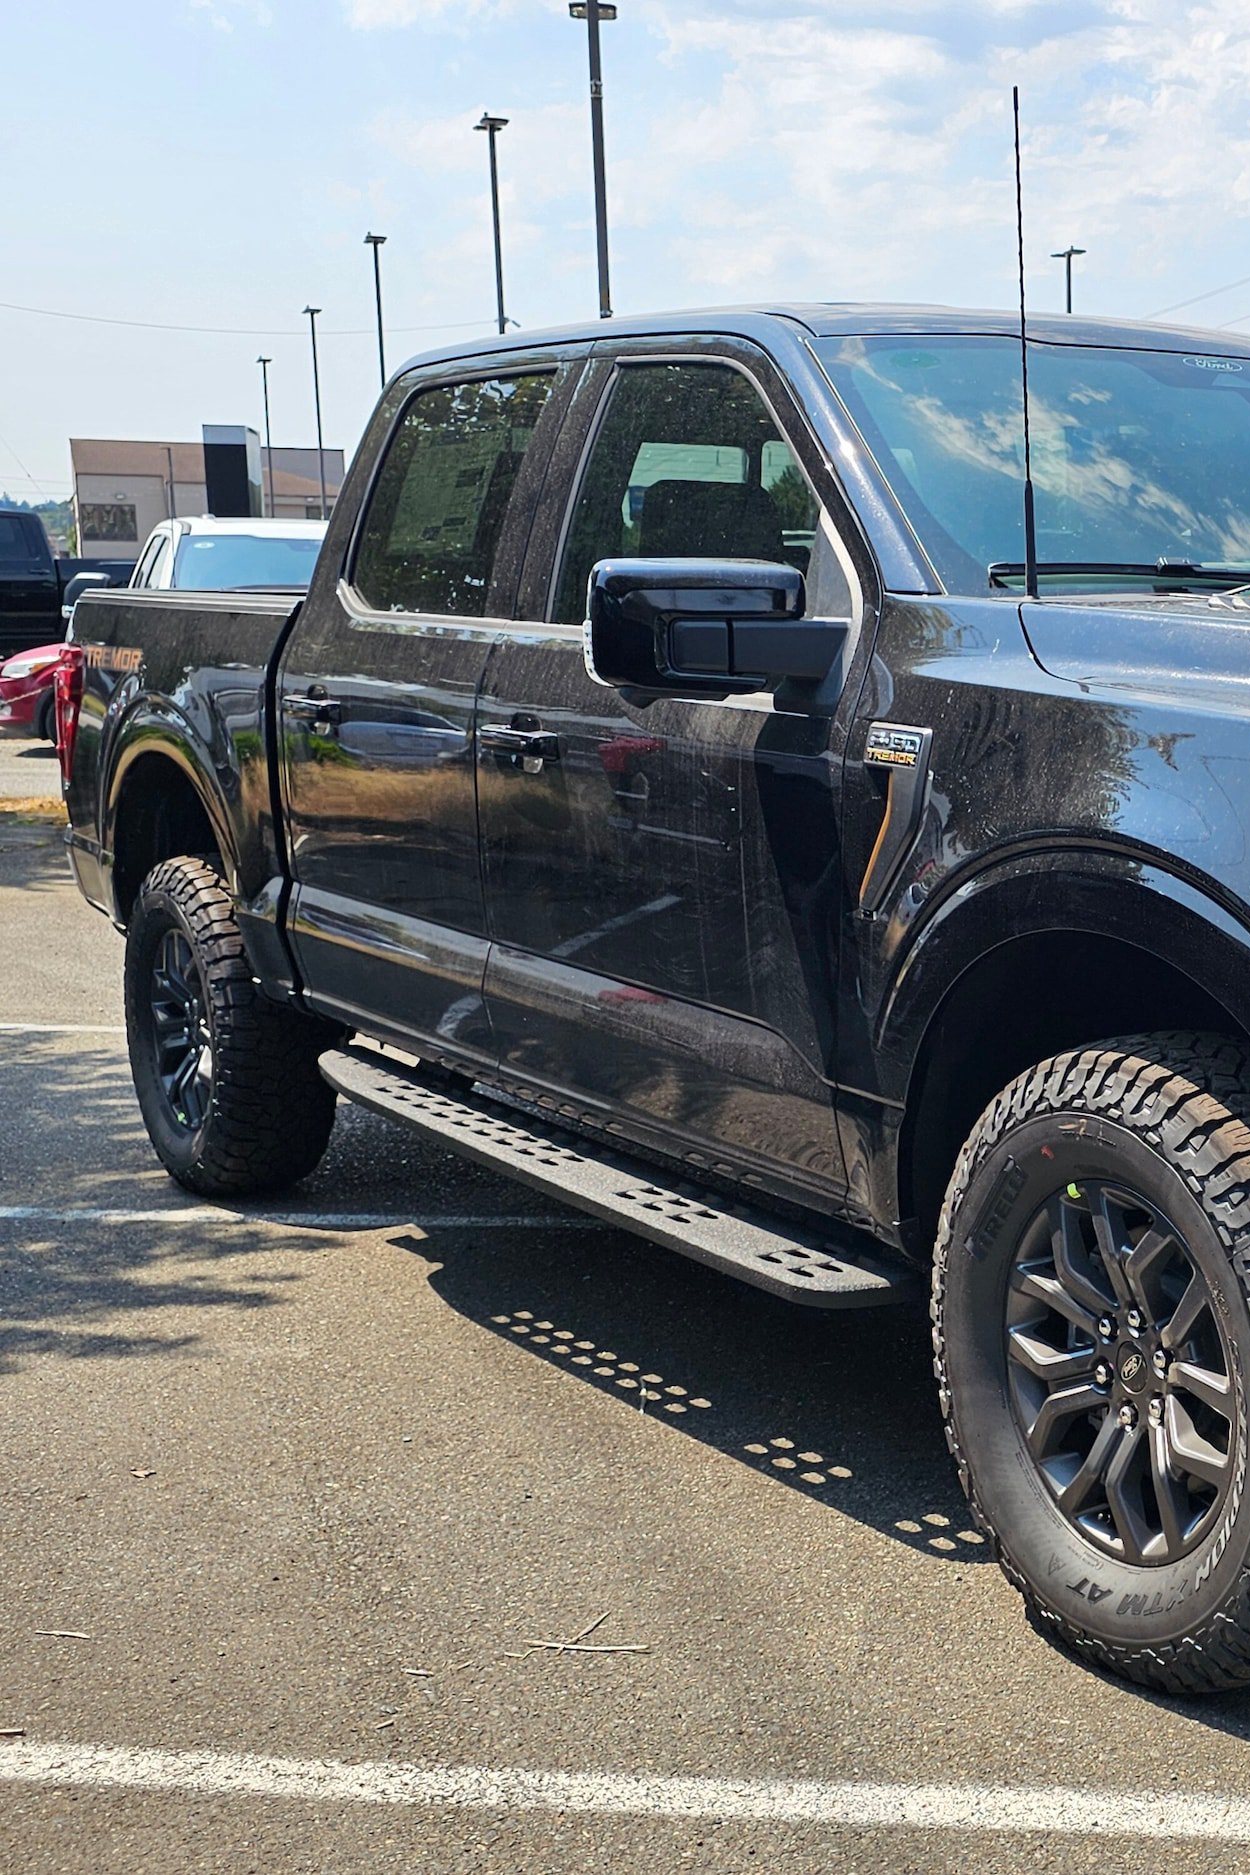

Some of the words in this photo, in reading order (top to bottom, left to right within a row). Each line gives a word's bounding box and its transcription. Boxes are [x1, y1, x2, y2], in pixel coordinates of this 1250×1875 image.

[86, 645, 143, 671] TREMOR
[866, 747, 917, 765] TREMOR
[1066, 1577, 1114, 1605] AT
